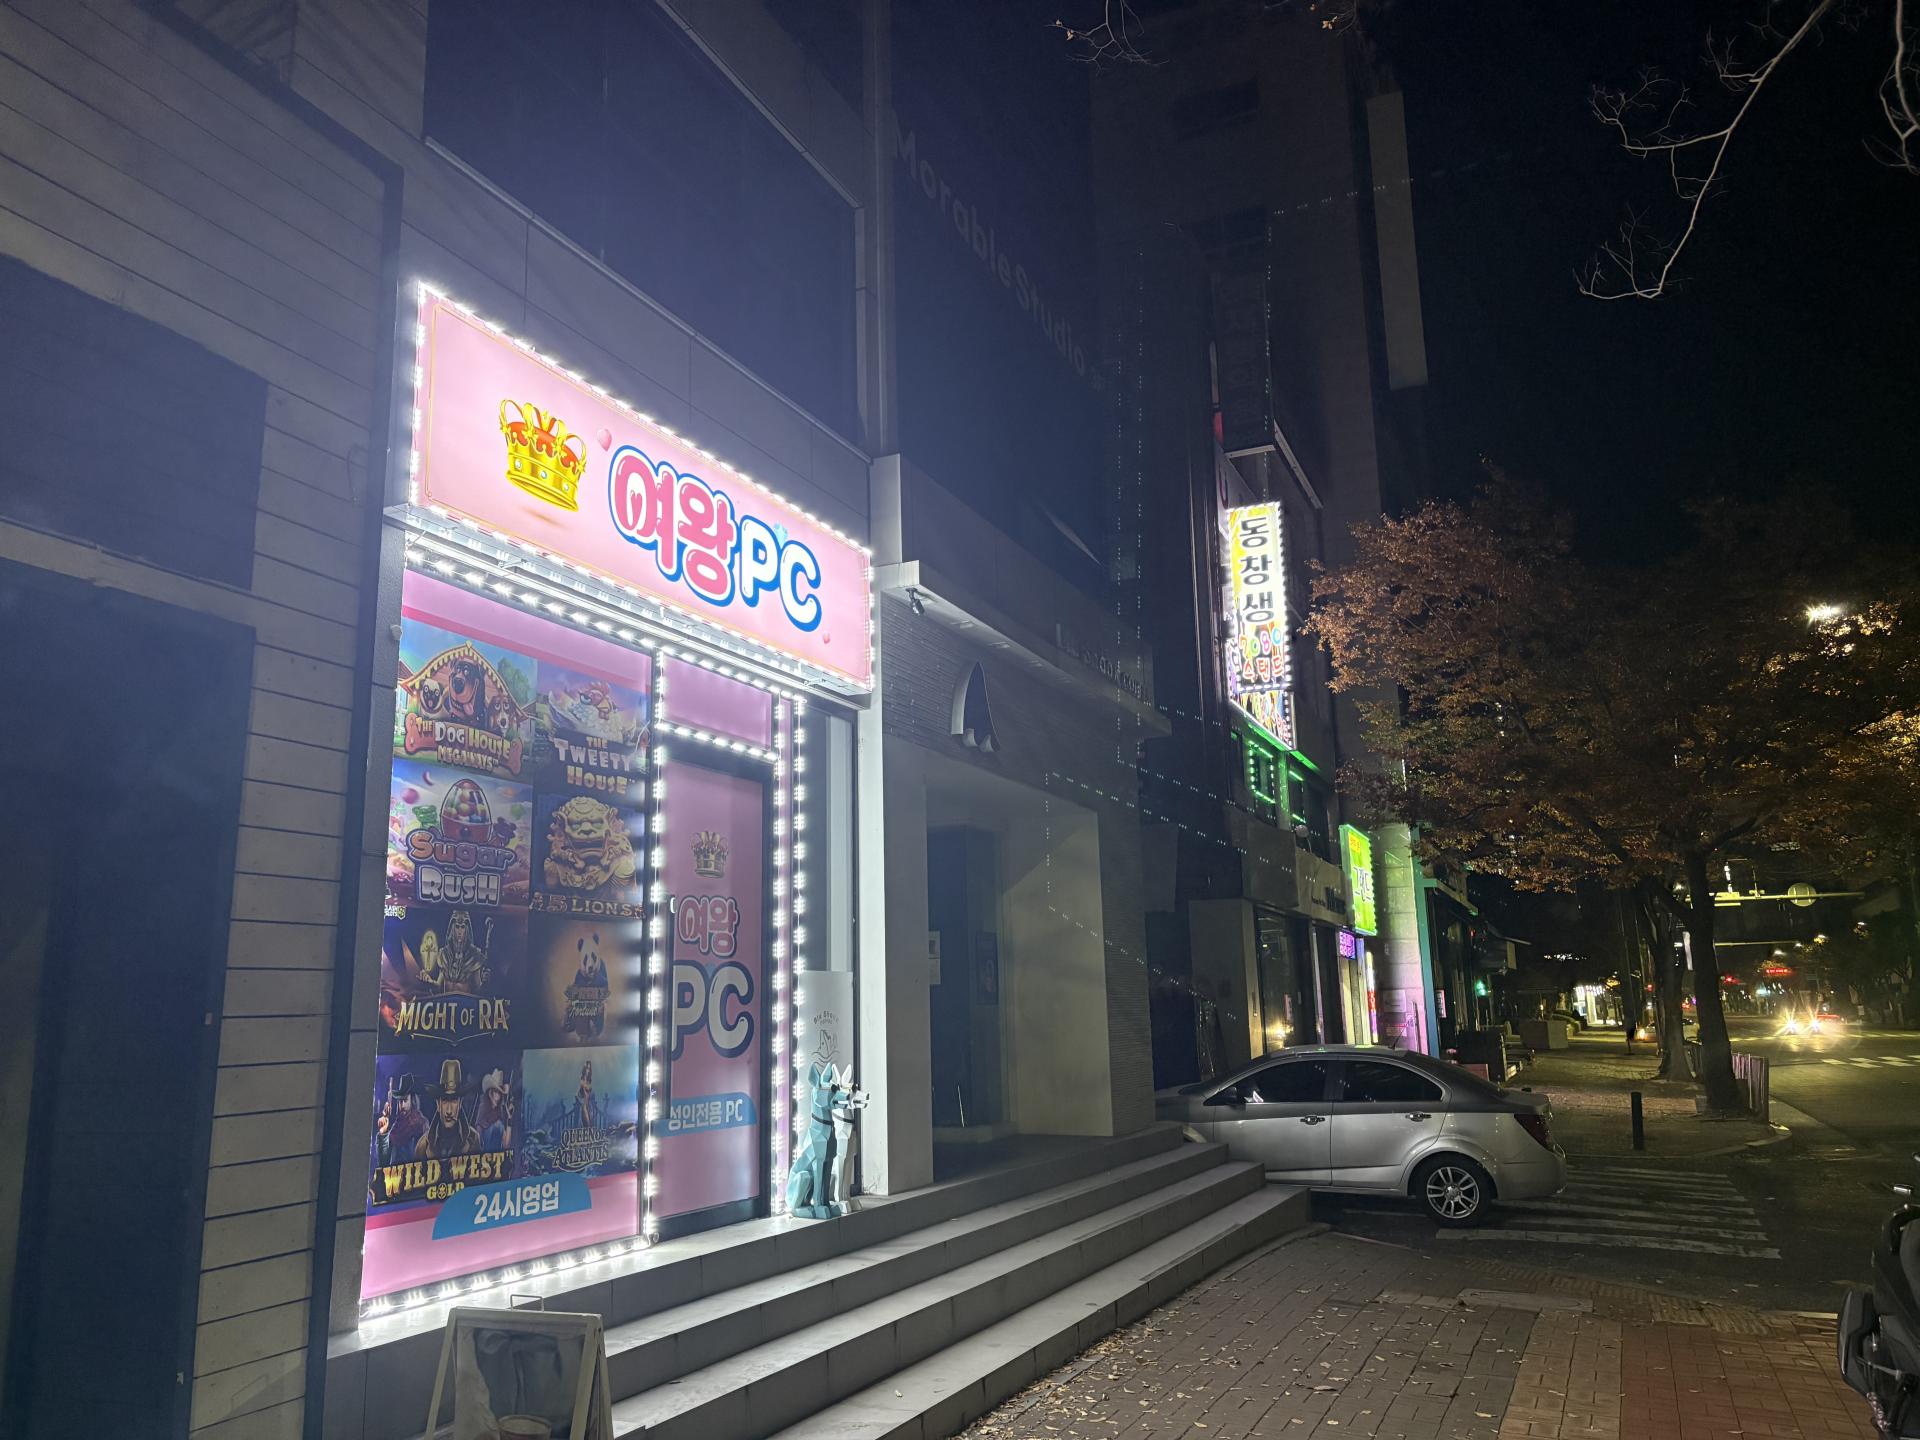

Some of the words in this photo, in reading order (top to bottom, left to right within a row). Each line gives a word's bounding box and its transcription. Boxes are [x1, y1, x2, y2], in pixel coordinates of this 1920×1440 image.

[1239, 516, 1275, 622] 동창생
[1239, 628, 1282, 658] 7080
[1243, 657, 1284, 682] 스탠드
[416, 716, 434, 734] THE
[435, 721, 465, 744] DOG
[469, 727, 511, 760] HOUSE
[553, 738, 631, 771] TWEETY
[567, 765, 628, 794] HOUSE
[408, 829, 517, 871] Sugar
[418, 865, 500, 906] RUSH
[571, 897, 633, 917] LIONS
[678, 896, 738, 957] 여왕
[396, 997, 458, 1036] MIGHT
[460, 1007, 475, 1026] OF
[479, 998, 509, 1032] RA
[672, 960, 754, 1060] PC
[668, 1101, 721, 1130] 성인전용
[725, 1099, 743, 1123] PC
[561, 1129, 594, 1148] QUEEN
[383, 1159, 441, 1197] WILD
[450, 1152, 505, 1180] WEST
[473, 1180, 560, 1224] 24시영업
